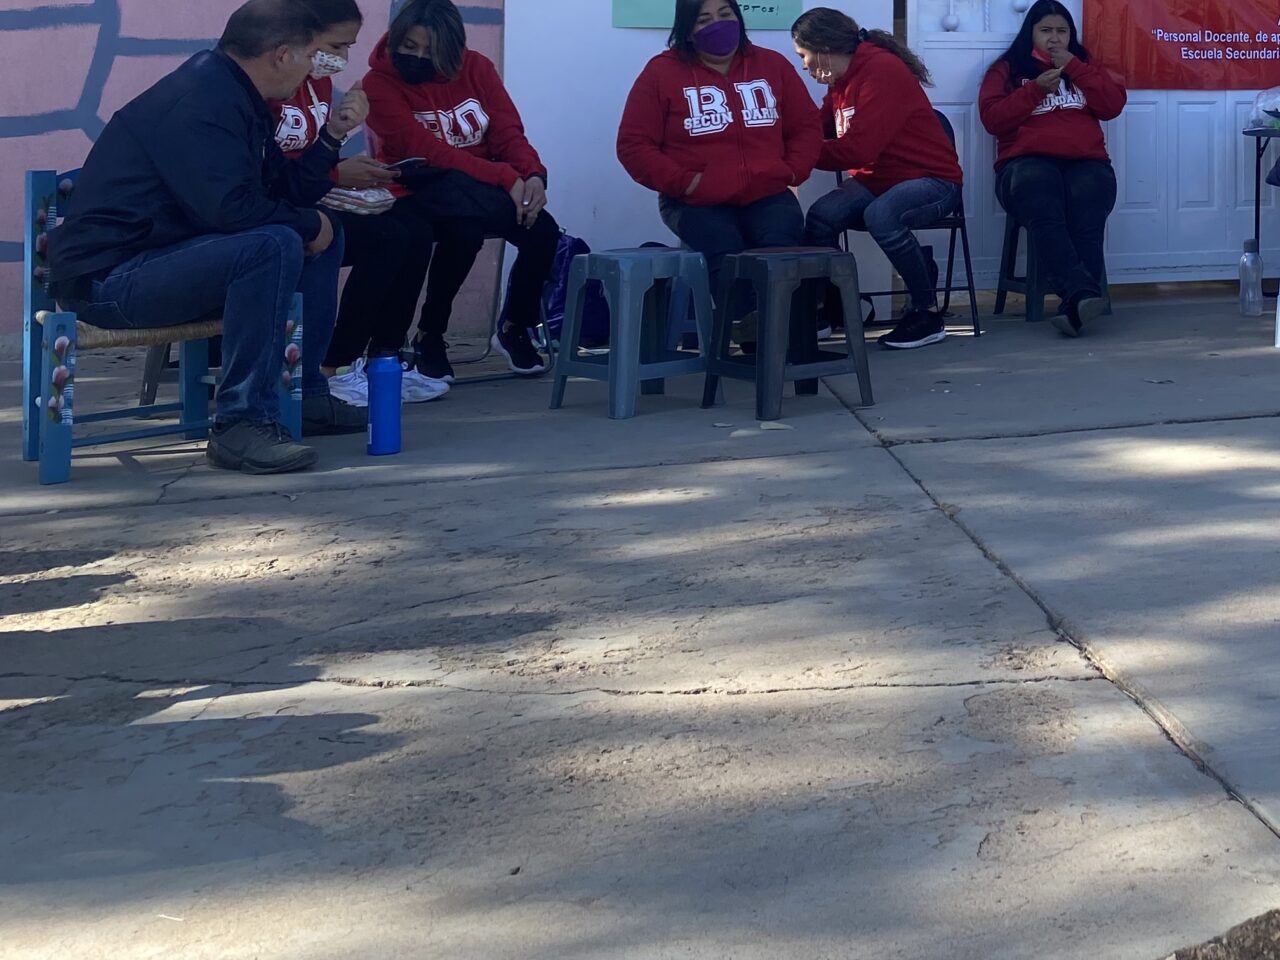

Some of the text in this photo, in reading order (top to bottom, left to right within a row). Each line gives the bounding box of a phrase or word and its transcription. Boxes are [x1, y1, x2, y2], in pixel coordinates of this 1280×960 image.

[1152, 28, 1201, 43] “Personal
[1204, 30, 1252, 44] Docente,
[1256, 31, 1268, 43] de
[1181, 47, 1222, 59] Escuela
